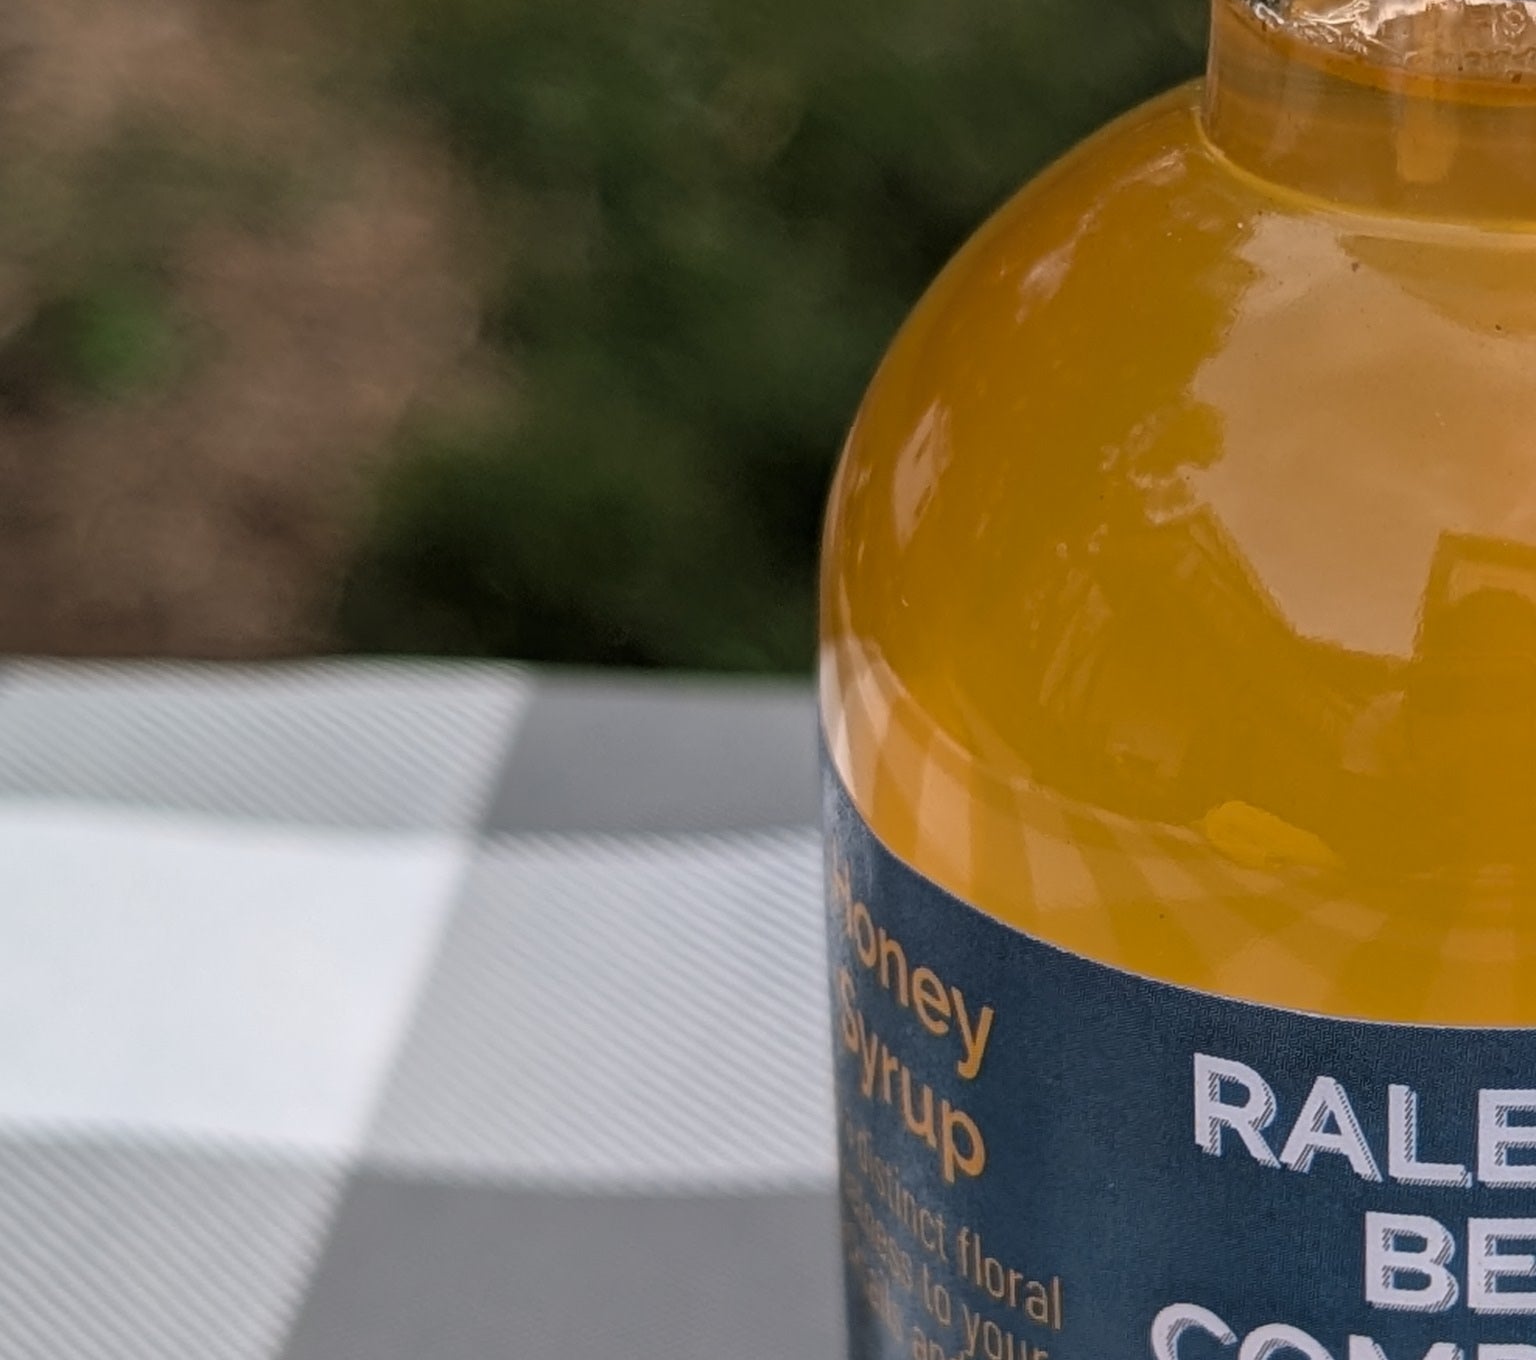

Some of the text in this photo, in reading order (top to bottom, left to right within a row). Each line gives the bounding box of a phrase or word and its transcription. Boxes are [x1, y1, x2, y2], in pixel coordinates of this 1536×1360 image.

[839, 965, 986, 1183] Syrup
[922, 1261, 951, 1328] to
[957, 1225, 1062, 1330] floral
